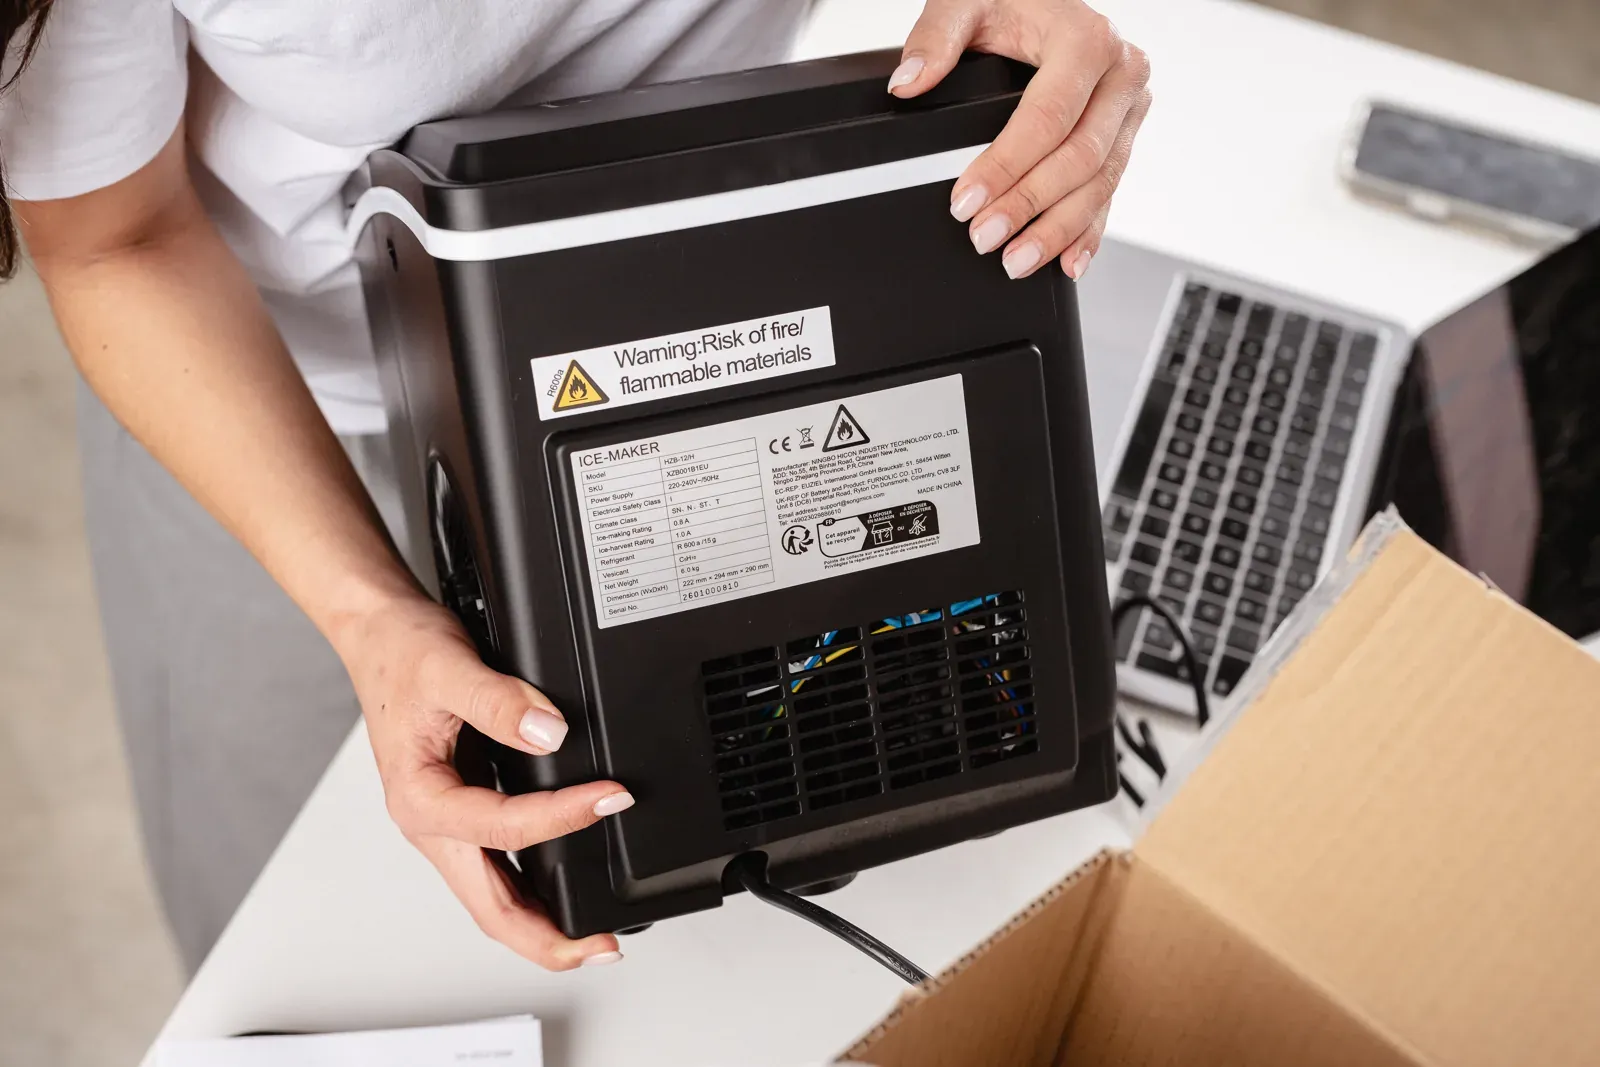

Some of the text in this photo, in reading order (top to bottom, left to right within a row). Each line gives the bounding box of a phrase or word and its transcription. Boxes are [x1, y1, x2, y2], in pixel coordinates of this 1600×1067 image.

[748, 323, 767, 344] of
[770, 316, 804, 340] fire/
[619, 344, 811, 395] flammable materials
[546, 369, 564, 398] R600a
[811, 454, 836, 465] NINGBO
[836, 450, 858, 459] HICON
[857, 443, 889, 456] INDUSTRY
[889, 433, 932, 449] TECHNOLOGY
[946, 428, 959, 436] LTD.
[578, 441, 660, 467] ICE-MAKER
[663, 453, 694, 465] HZB-12/H
[666, 463, 708, 477] XZB001B1EU
[823, 472, 857, 484] International
[858, 468, 876, 476] GmbH
[915, 456, 932, 464] 58454
[933, 452, 951, 460] Witten
[585, 471, 606, 480] Model
[773, 477, 793, 485] Ningbo
[794, 472, 818, 481] Zhejiang
[588, 484, 603, 492] SKU
[775, 494, 799, 504] UK-REP
[800, 491, 809, 499] OF
[810, 488, 830, 497] Battery
[910, 467, 922, 475] LTD
[812, 492, 834, 502] Imperial
[936, 467, 949, 475] CV8
[949, 464, 960, 472] 3LF
[917, 485, 934, 494] MADE
[942, 480, 962, 488] CHINA
[590, 491, 633, 504] Power Supply
[592, 498, 661, 516] Electrical Safety Class
[777, 511, 794, 519] Email
[594, 520, 618, 530] Climate
[824, 518, 833, 526] FR
[596, 525, 652, 541] Ice-making Rating
[836, 526, 860, 537] appareil
[598, 538, 654, 553] Ice-harvest Rating
[683, 540, 695, 548] 600
[834, 535, 855, 543] recycle
[918, 540, 936, 548] appareil
[600, 554, 635, 565] Refrigerant
[602, 568, 629, 578] Vesicant
[682, 579, 694, 587] 222
[713, 571, 725, 580] 294
[616, 578, 638, 587] Weight
[606, 591, 639, 602] Dimension
[682, 580, 738, 601] 2601000810
[608, 606, 626, 615] Serial
